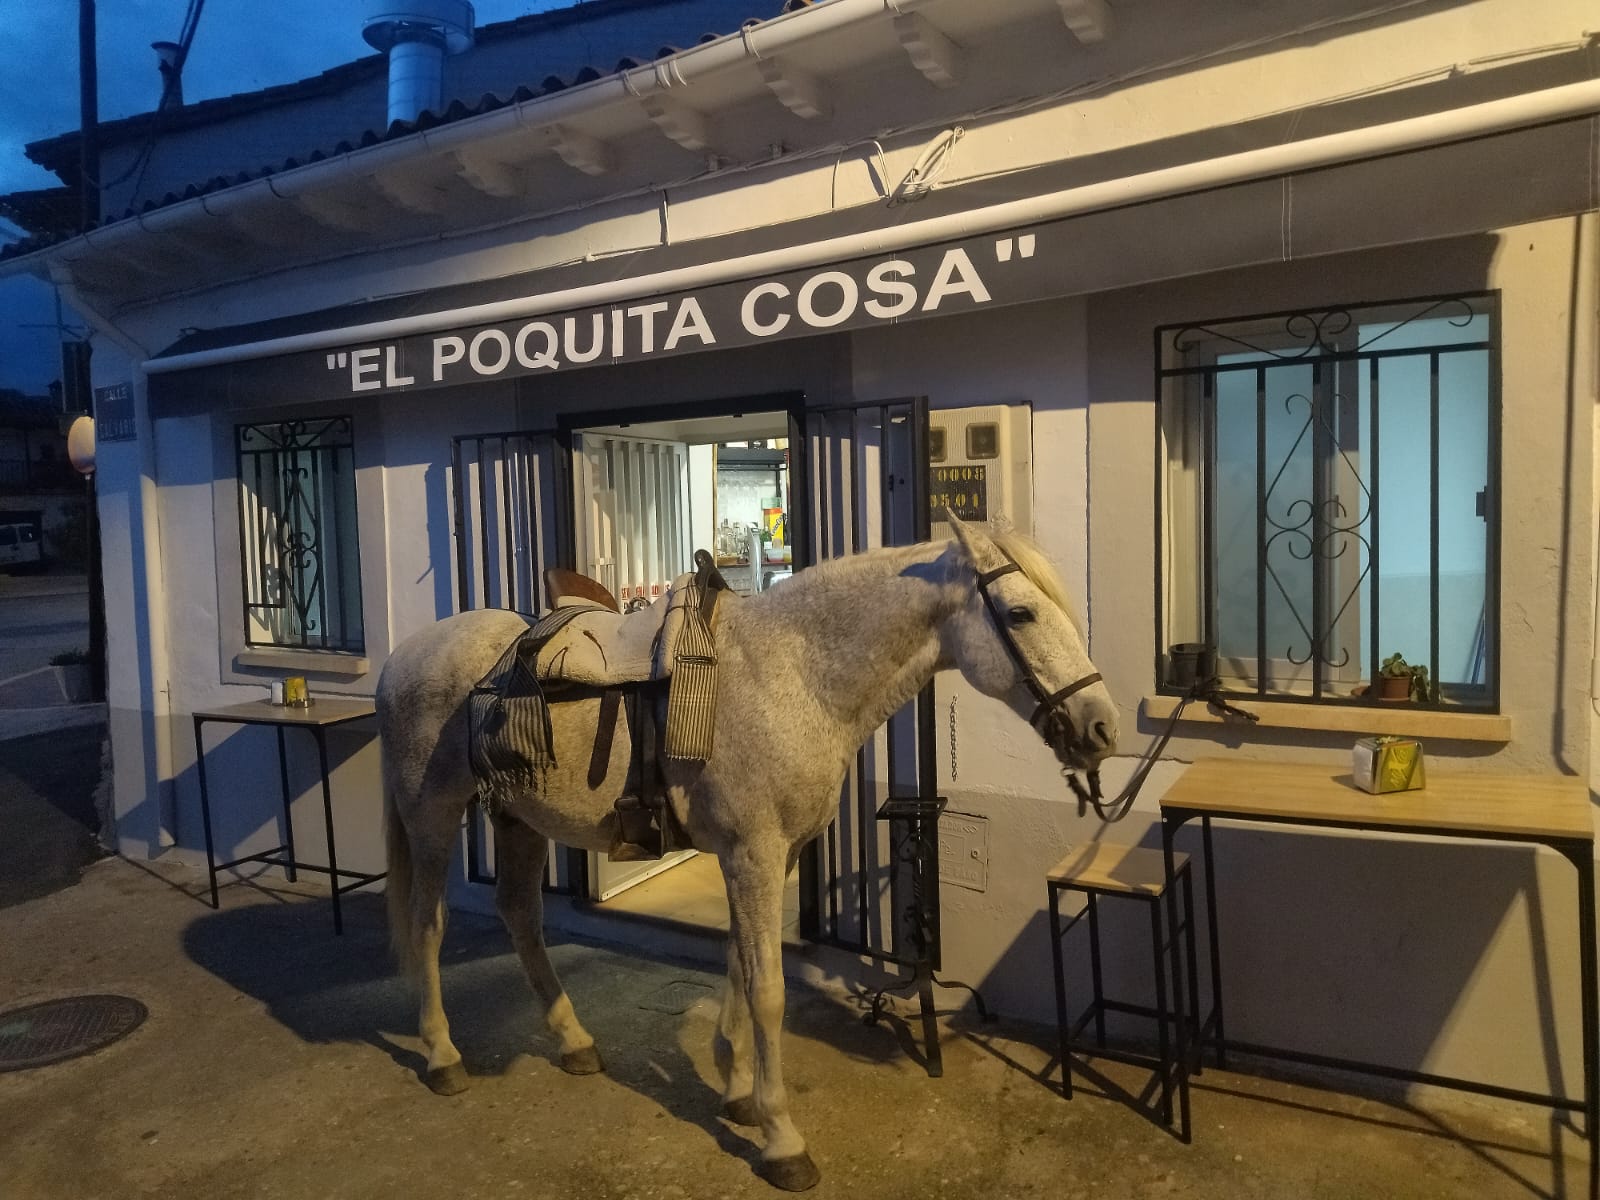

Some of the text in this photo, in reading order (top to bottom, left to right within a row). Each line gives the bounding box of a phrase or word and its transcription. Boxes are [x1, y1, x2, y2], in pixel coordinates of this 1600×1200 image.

[326, 233, 1036, 392] "EL POQUITA COSA"
